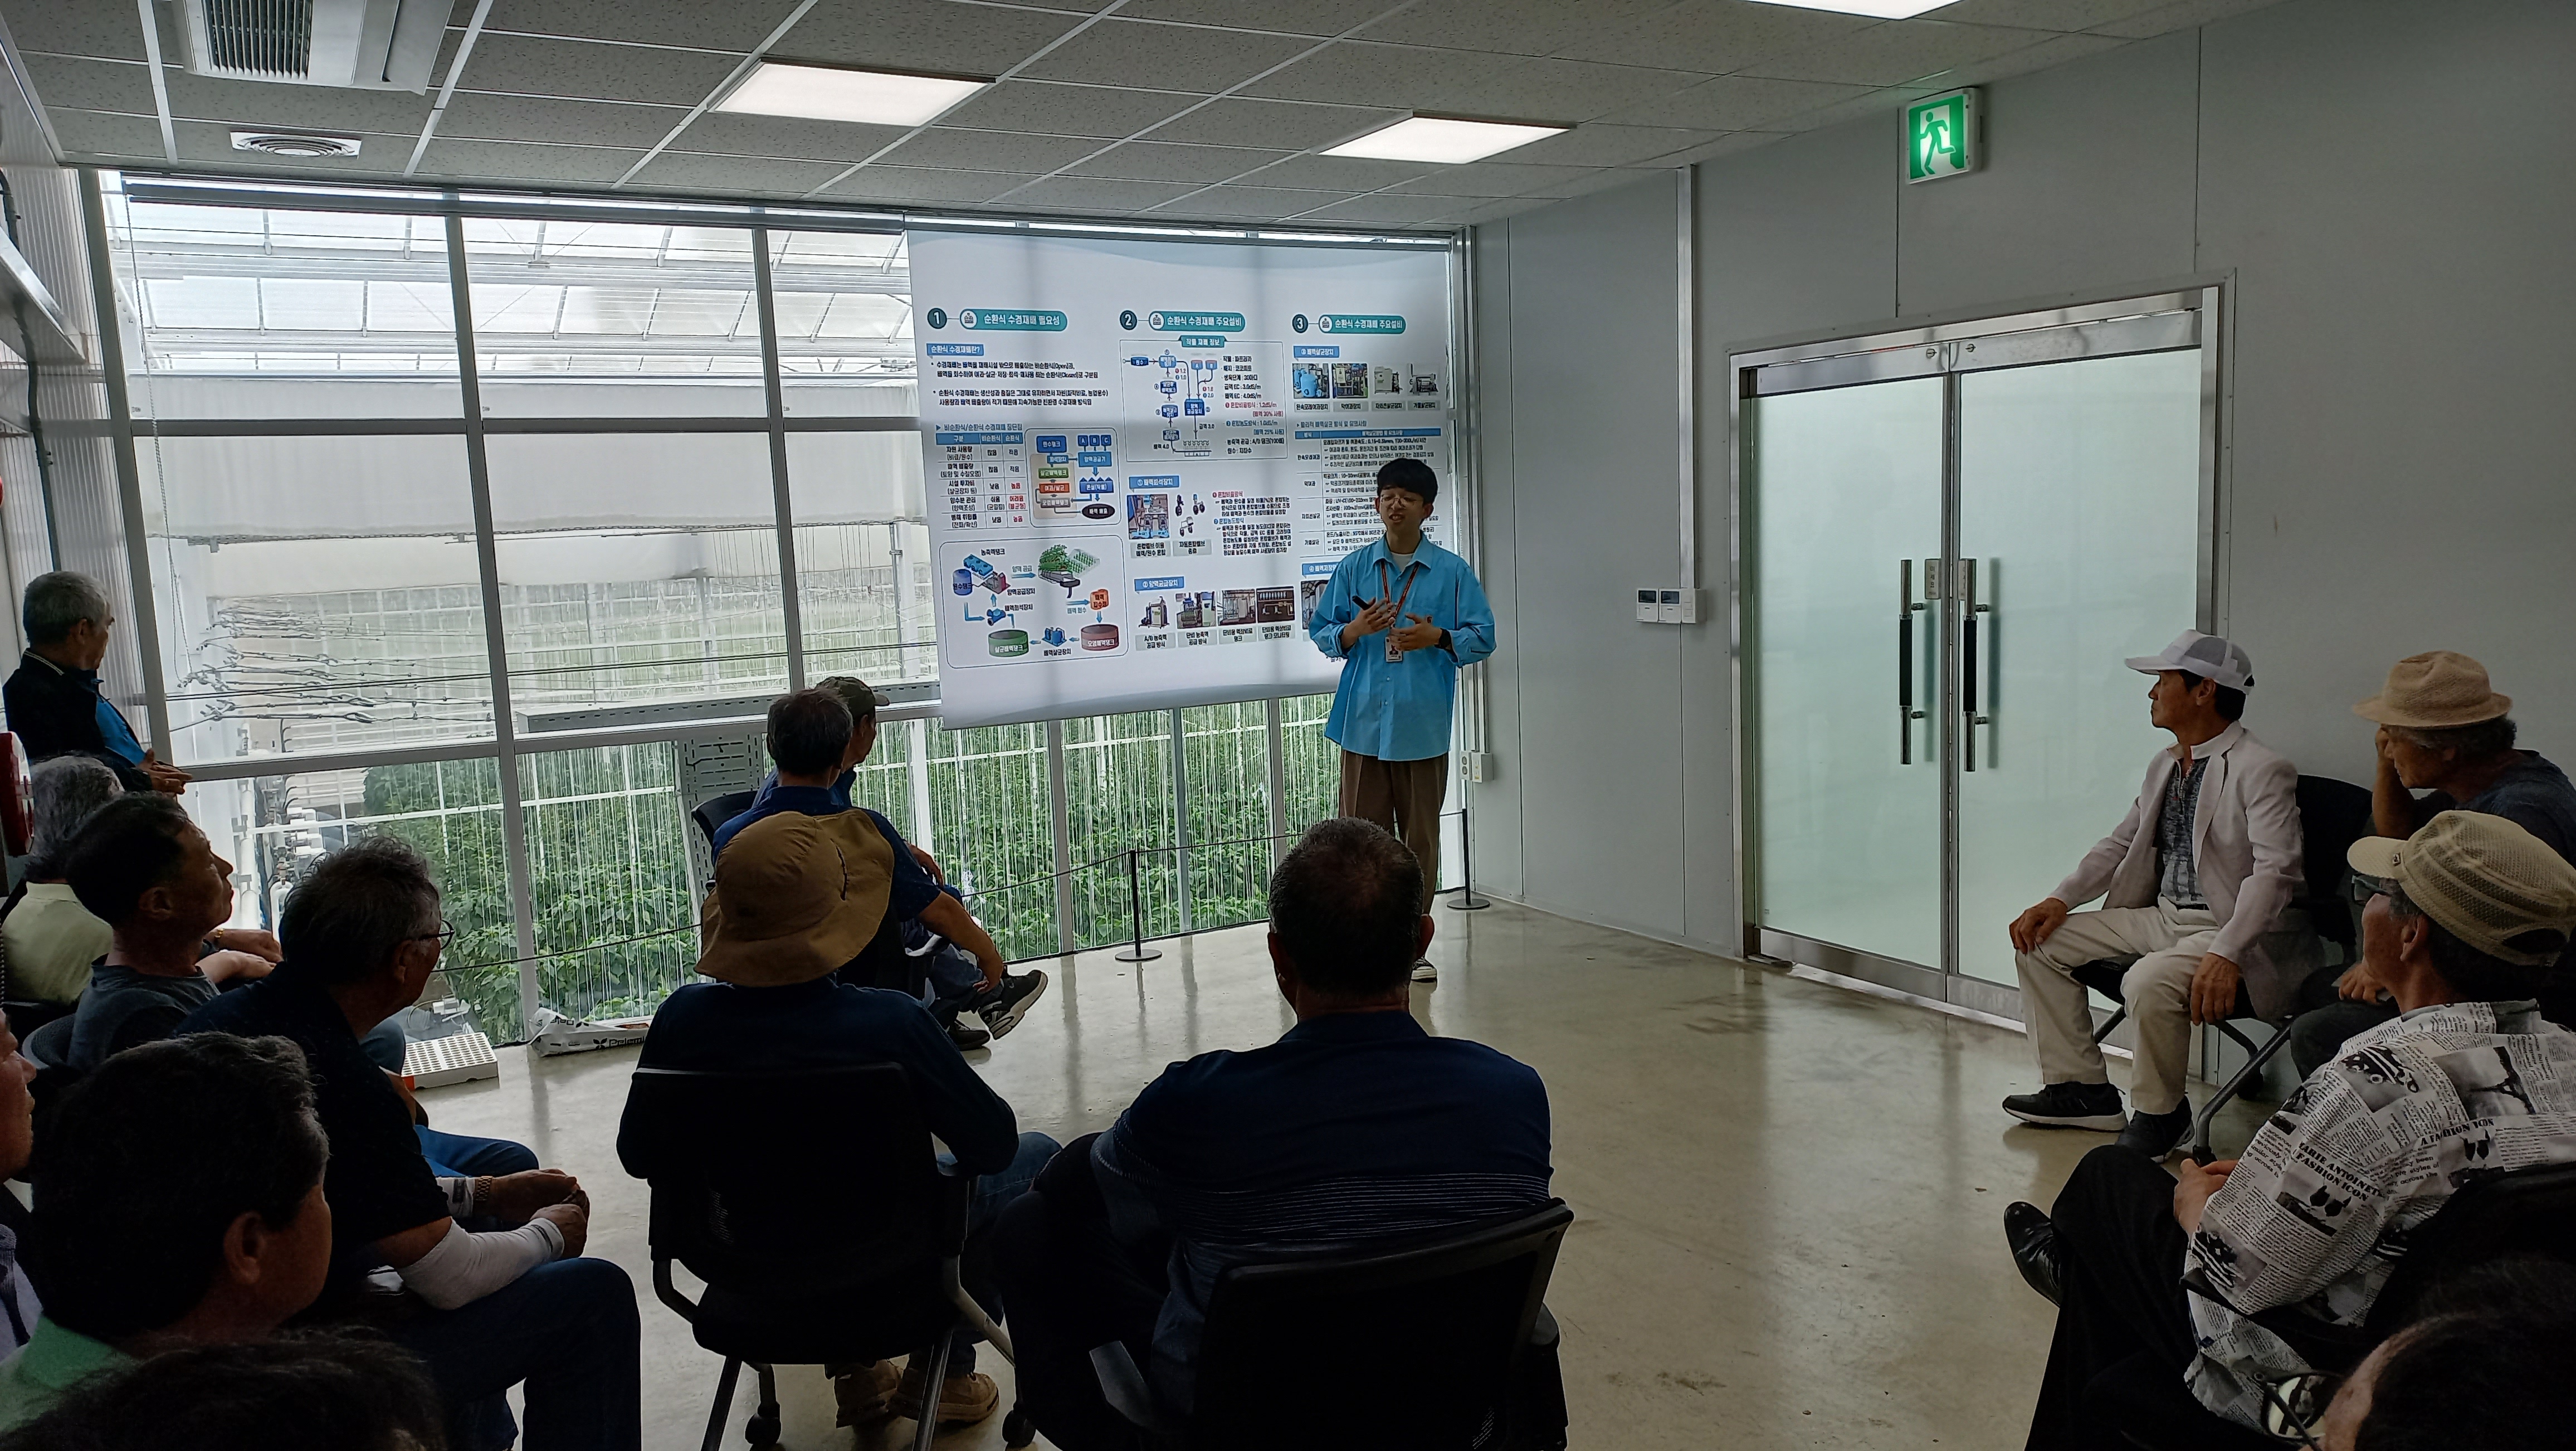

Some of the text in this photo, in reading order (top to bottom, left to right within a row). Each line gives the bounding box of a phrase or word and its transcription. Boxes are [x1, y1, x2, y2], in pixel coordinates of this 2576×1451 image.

[933, 311, 940, 324] 1
[984, 314, 1060, 325] 순환식 수경재배 필요성
[1125, 314, 1132, 326] 2
[1167, 316, 1242, 327] 순환식 수경재배 주요설비
[1297, 317, 1304, 329] 3
[1335, 319, 1403, 329] 순환식 수경재배 주요설비
[949, 345, 980, 354] 수경재배란?
[609, 1036, 645, 1047] Pelemi
[2421, 1137, 2428, 1146] A
[2429, 1123, 2470, 1142] FAHION
[2251, 1144, 2268, 1158] imilar
[2255, 1139, 2281, 1158] reviously
[2296, 1152, 2369, 1201] FASHION ICON
